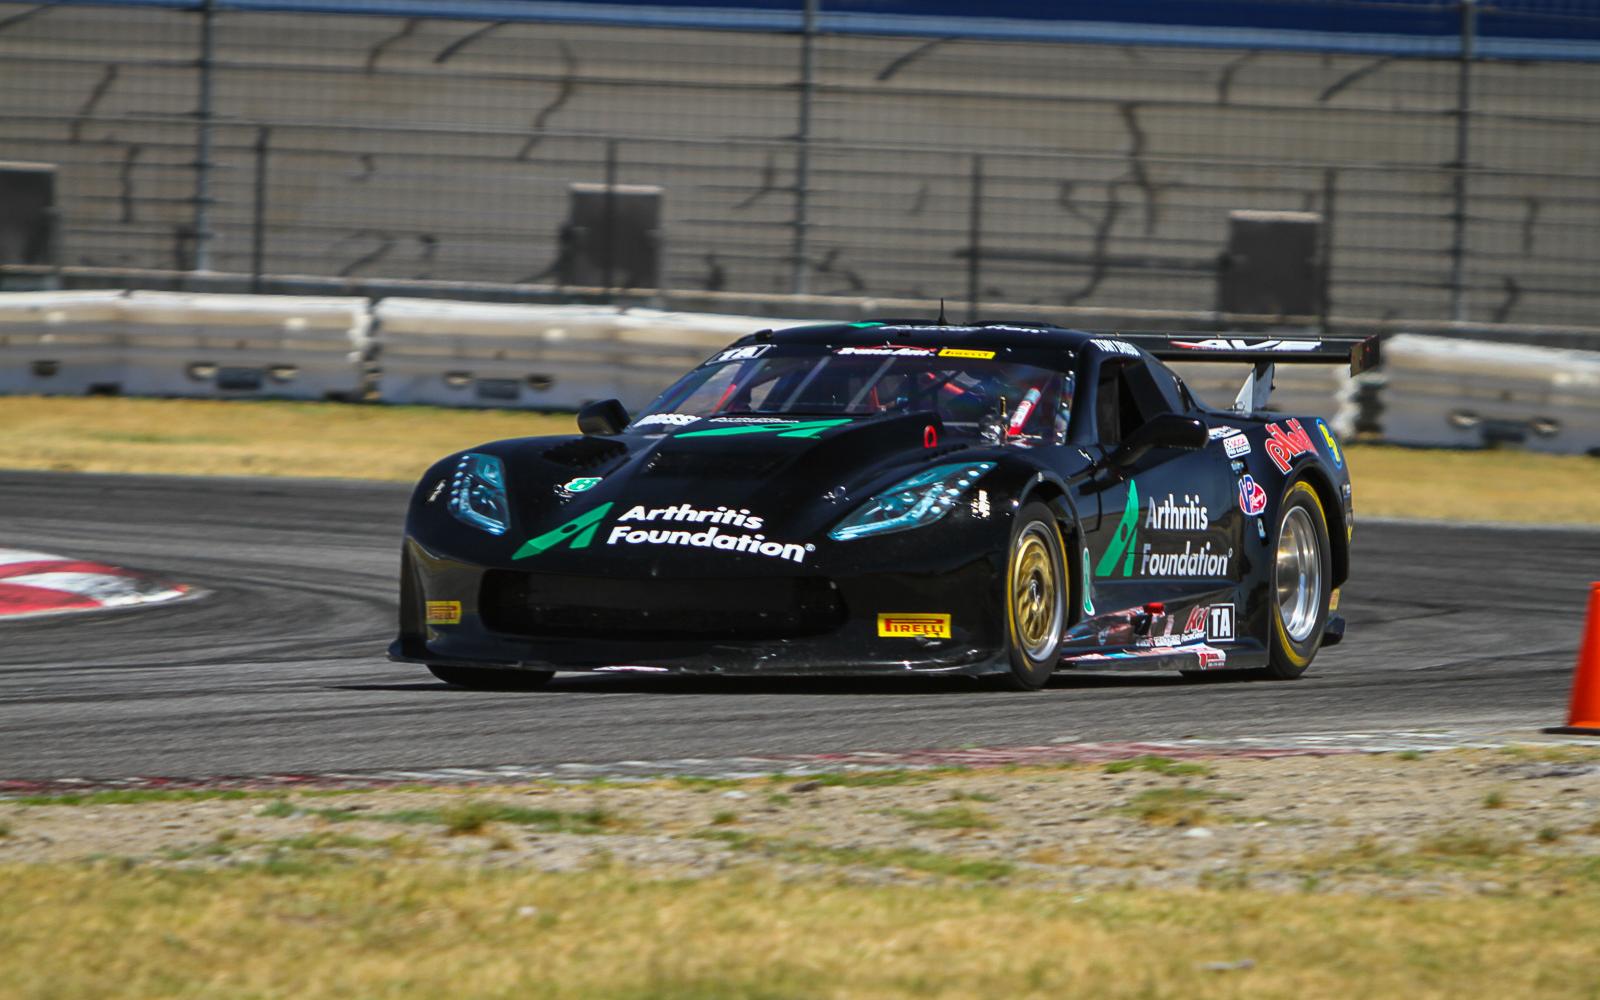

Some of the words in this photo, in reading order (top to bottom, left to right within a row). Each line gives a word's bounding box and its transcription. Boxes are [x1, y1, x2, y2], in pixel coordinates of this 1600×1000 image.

[617, 503, 764, 529] Arthritis
[1145, 493, 1208, 531] Arthritis
[884, 618, 945, 633] PIRELLI
[1184, 605, 1209, 633] K1
[1211, 608, 1231, 638] TA
